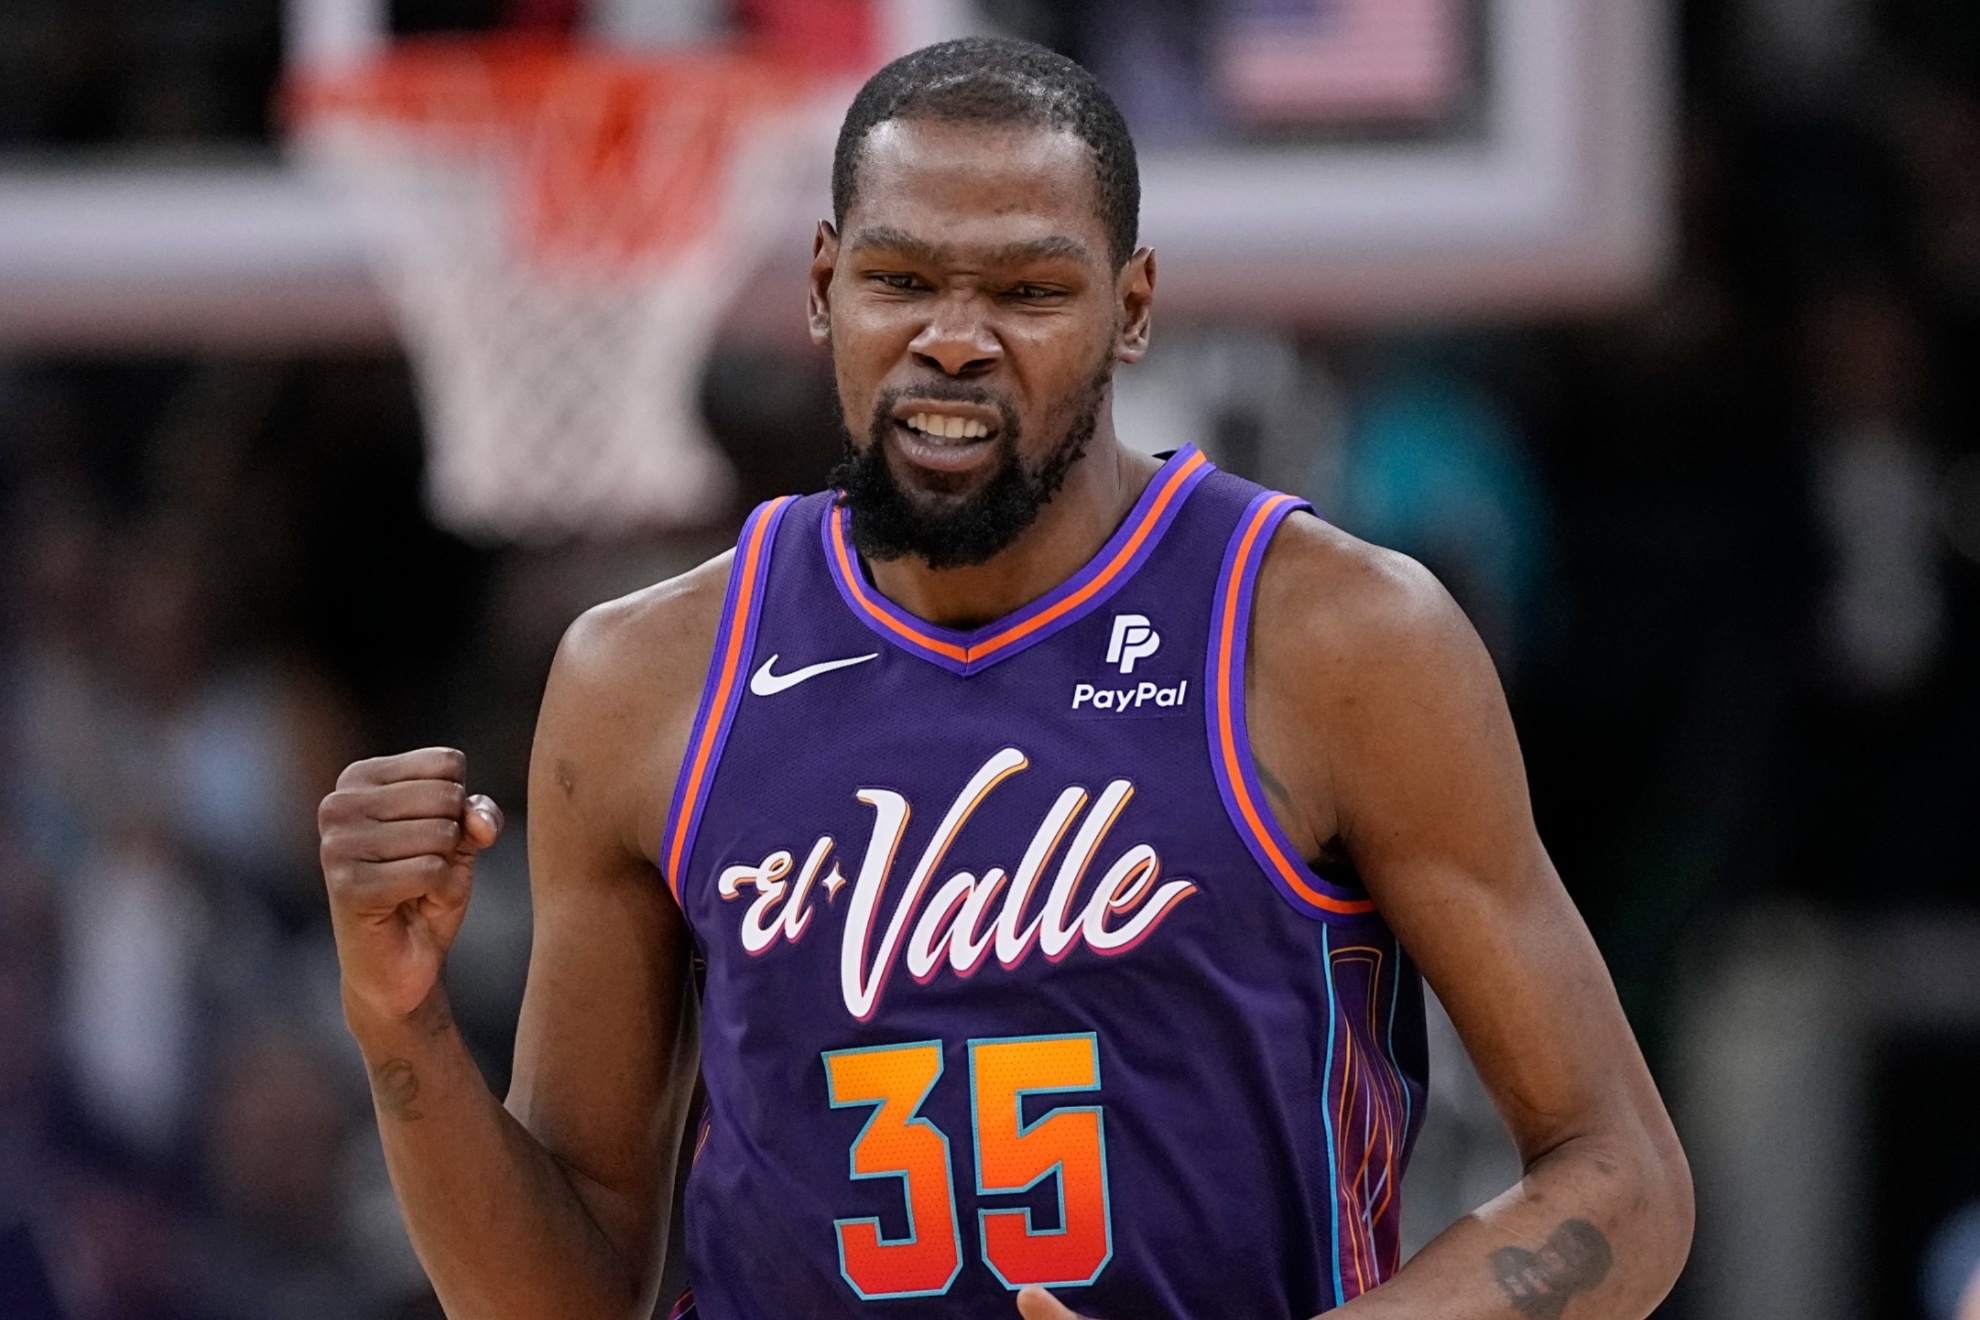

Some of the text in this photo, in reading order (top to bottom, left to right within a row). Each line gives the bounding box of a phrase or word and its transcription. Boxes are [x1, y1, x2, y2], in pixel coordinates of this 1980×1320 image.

[1072, 680, 1187, 712] PayPal
[718, 747, 1197, 1021] El Valle
[820, 1032, 1113, 1300] 35
